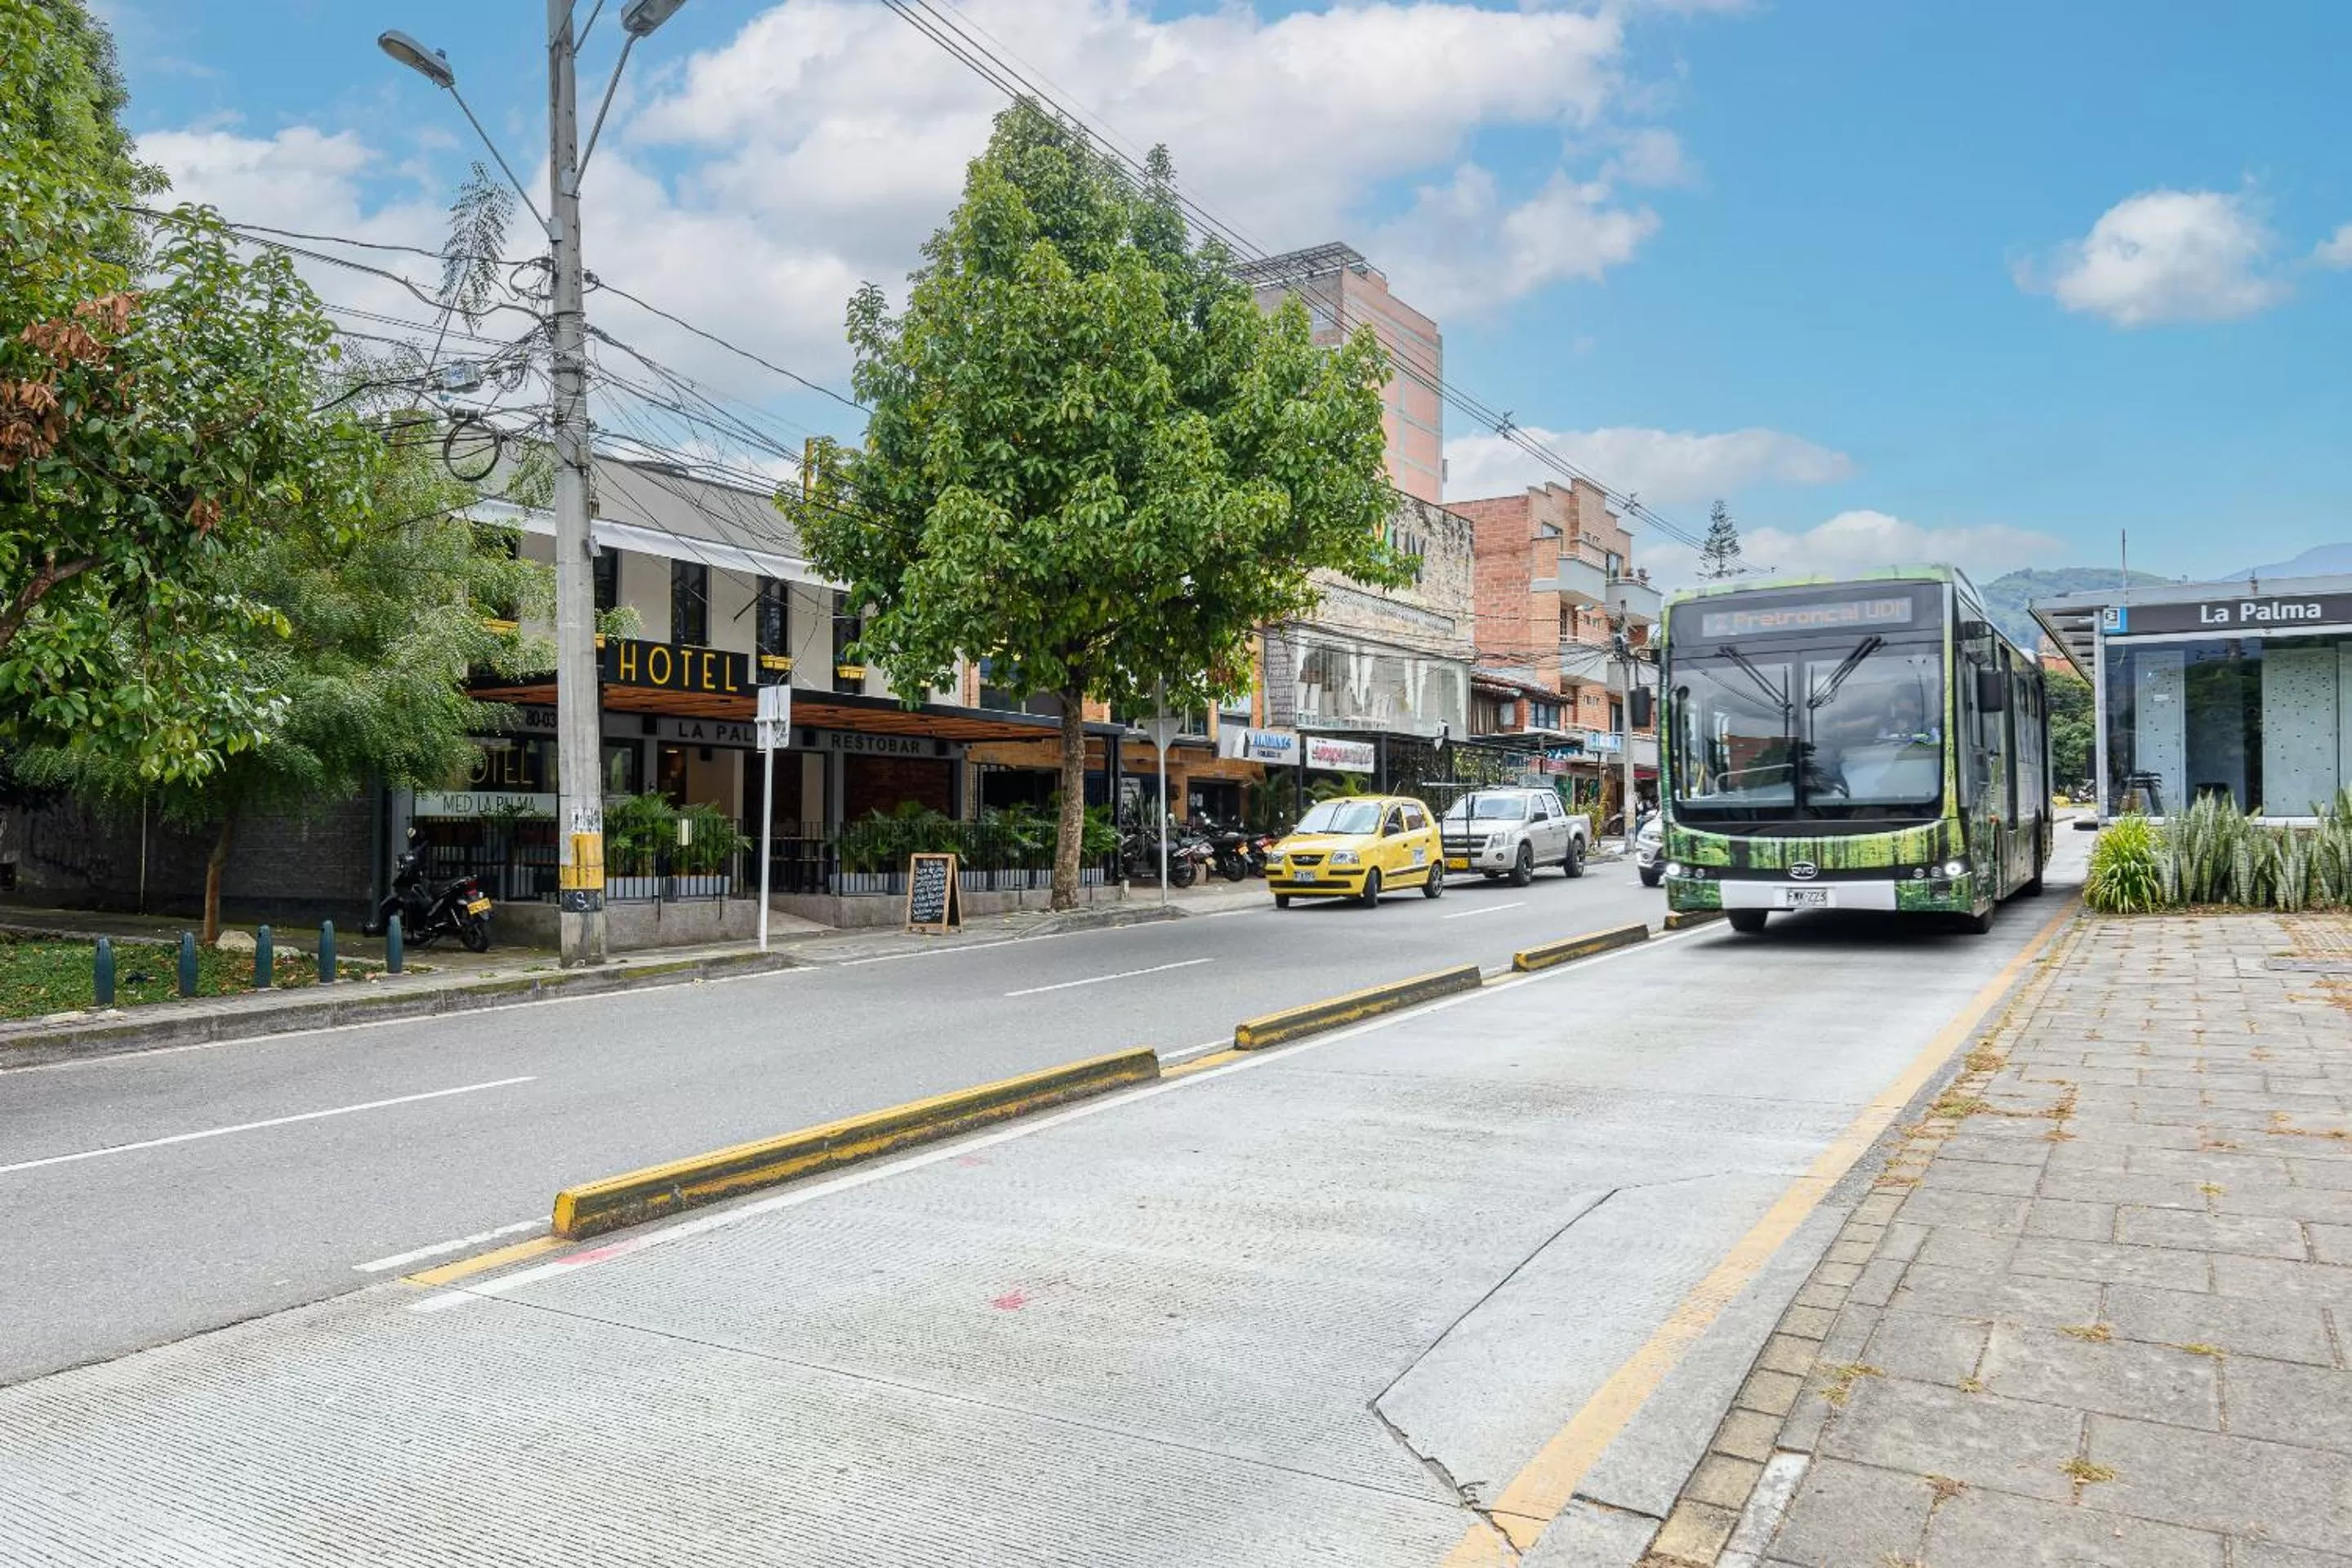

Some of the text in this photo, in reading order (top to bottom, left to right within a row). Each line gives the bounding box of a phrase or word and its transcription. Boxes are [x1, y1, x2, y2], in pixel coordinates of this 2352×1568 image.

[2201, 601, 2321, 623] La Palma
[619, 644, 738, 693] HOTEL
[678, 721, 753, 743] LA PAL
[831, 734, 920, 754] RESTOBAR
[466, 744, 534, 785] OTEL
[443, 795, 473, 813] MED
[478, 795, 492, 813] LA
